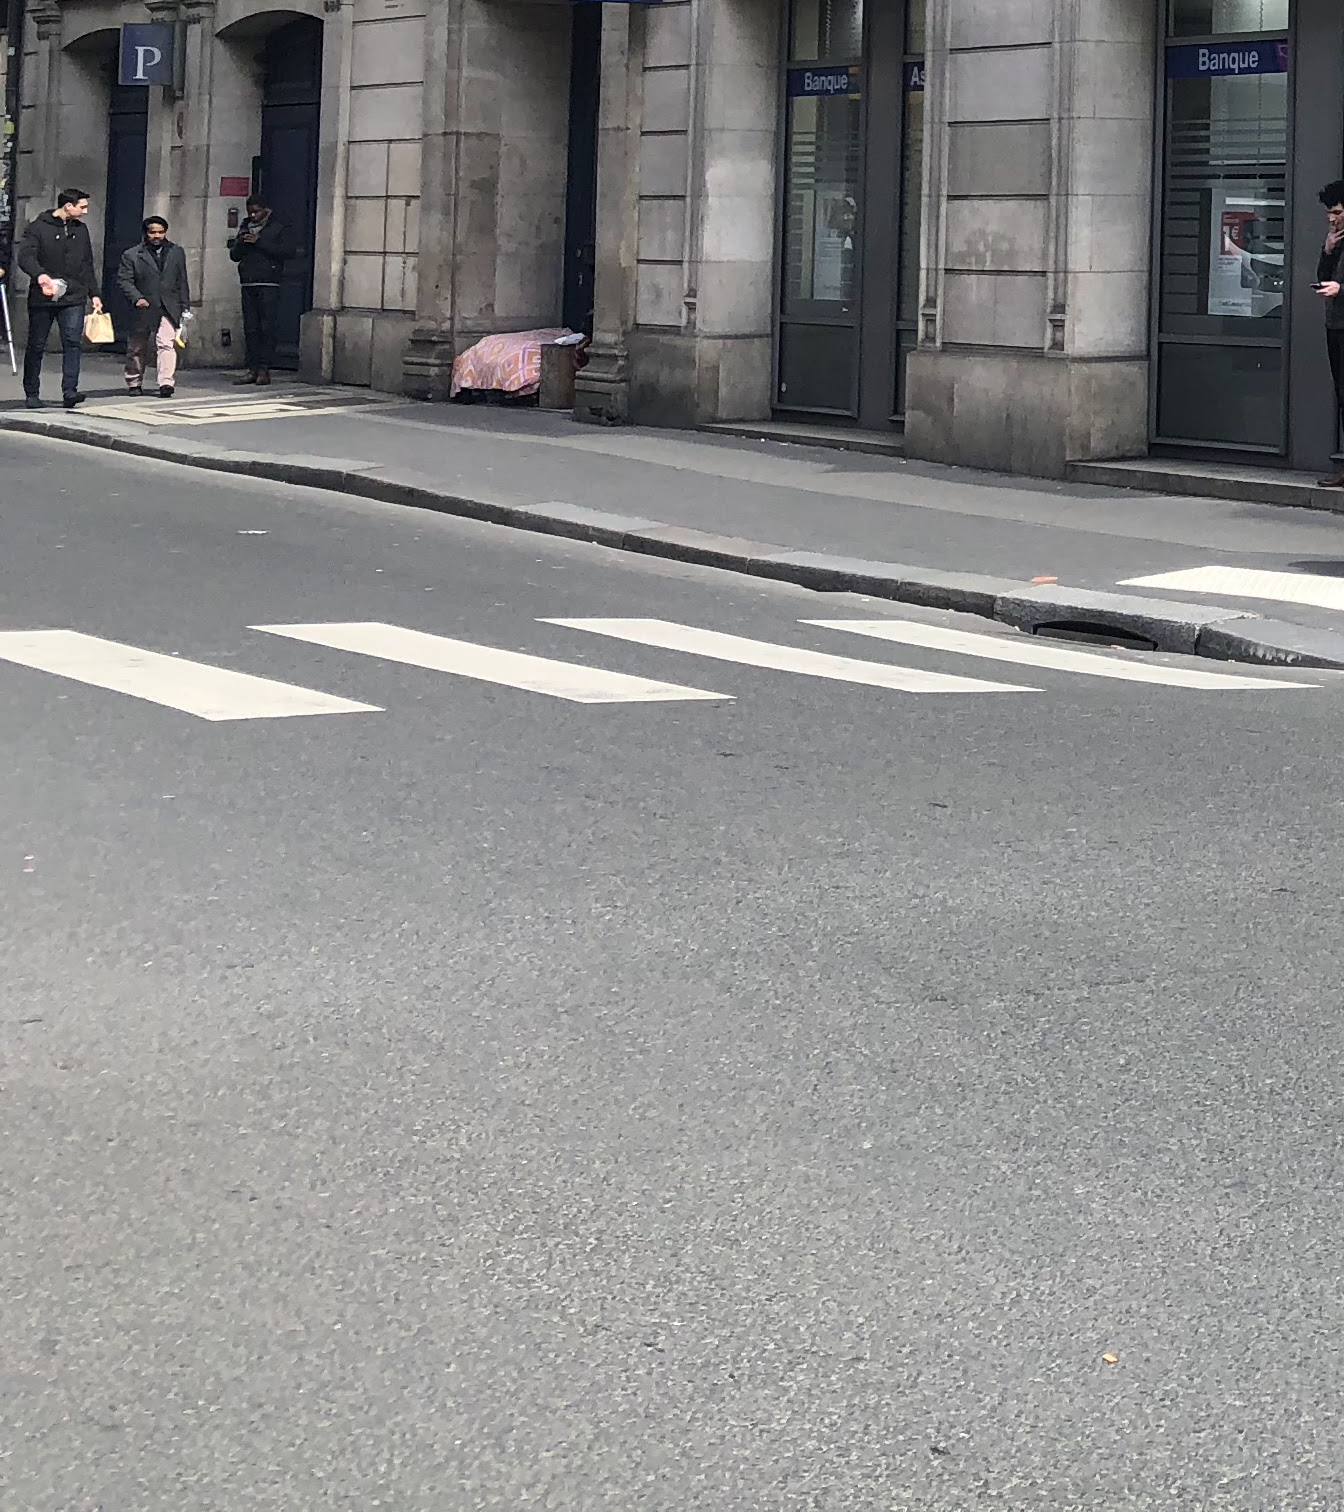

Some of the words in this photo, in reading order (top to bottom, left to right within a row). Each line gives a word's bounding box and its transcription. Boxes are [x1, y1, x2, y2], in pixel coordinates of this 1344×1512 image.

[132, 45, 162, 80] P
[1198, 48, 1259, 74] Banque
[804, 71, 848, 94] Banque
